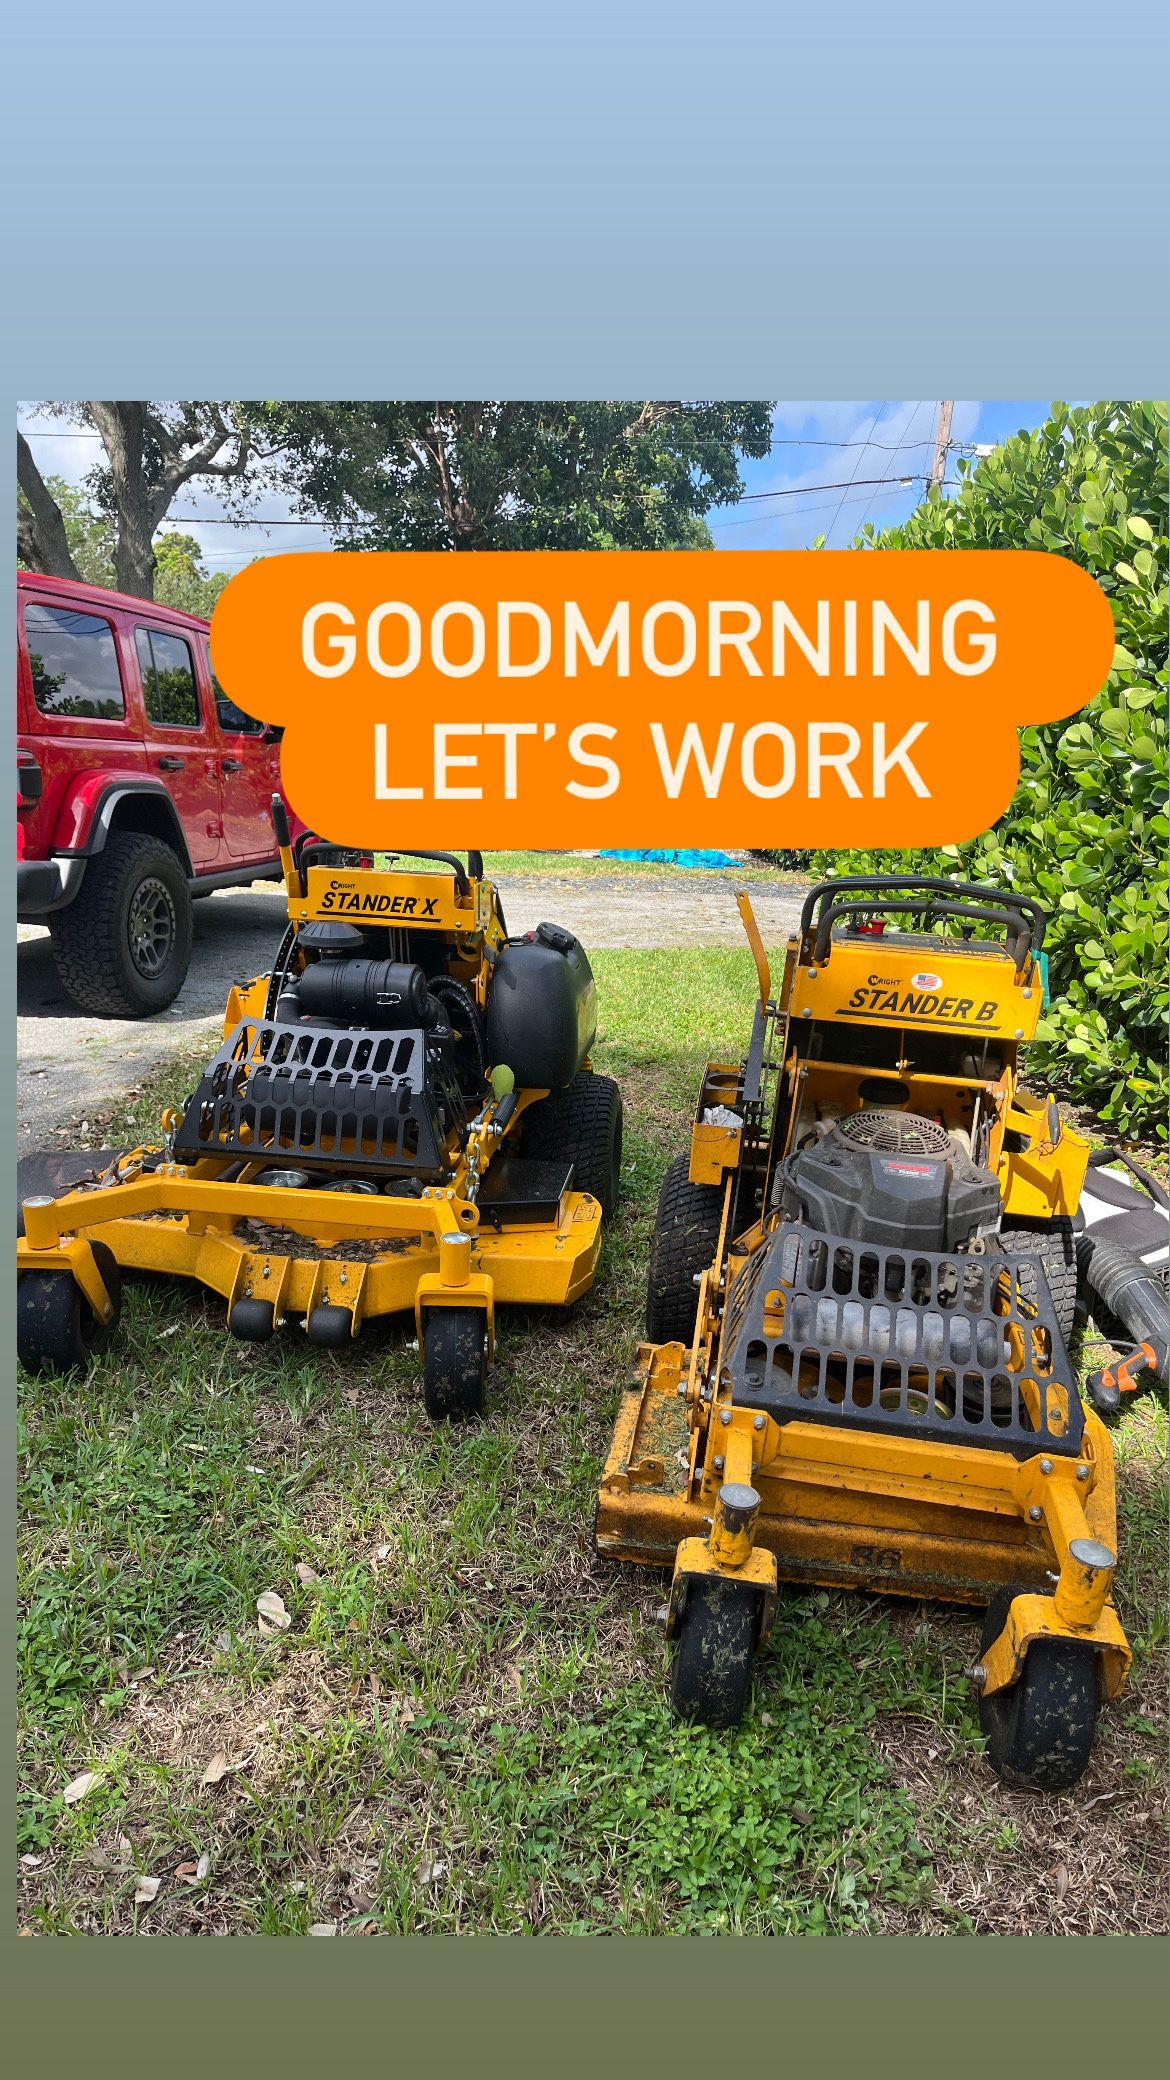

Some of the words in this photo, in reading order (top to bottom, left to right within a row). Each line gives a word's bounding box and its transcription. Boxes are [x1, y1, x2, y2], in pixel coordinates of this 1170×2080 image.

[321, 891, 418, 914] STANDER
[420, 898, 439, 916] X
[867, 974, 901, 987] WRIGHT
[848, 987, 974, 1019] STANDER
[974, 1000, 999, 1021] B
